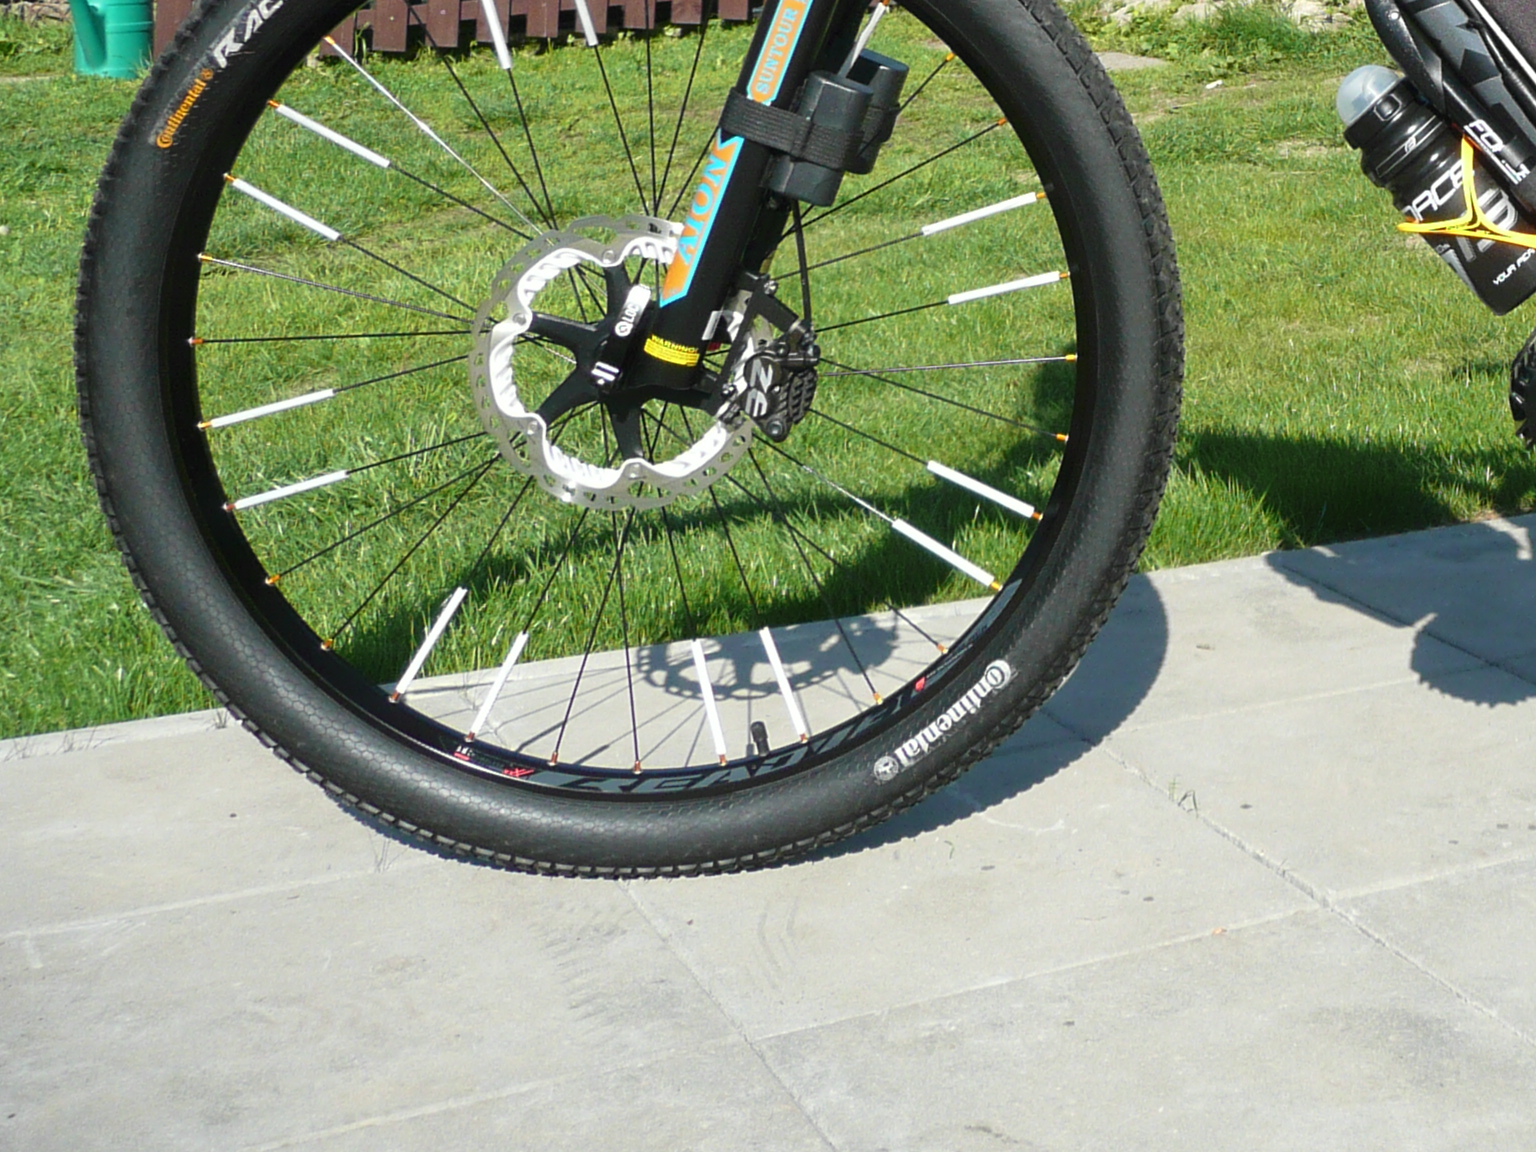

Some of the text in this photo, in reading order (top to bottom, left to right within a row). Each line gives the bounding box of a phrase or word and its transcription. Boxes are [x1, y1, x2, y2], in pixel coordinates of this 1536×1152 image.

[755, 7, 798, 94] SUNTOUR
[157, 76, 208, 148] Continental
[680, 153, 727, 264] AION
[895, 659, 1012, 768] Continental
